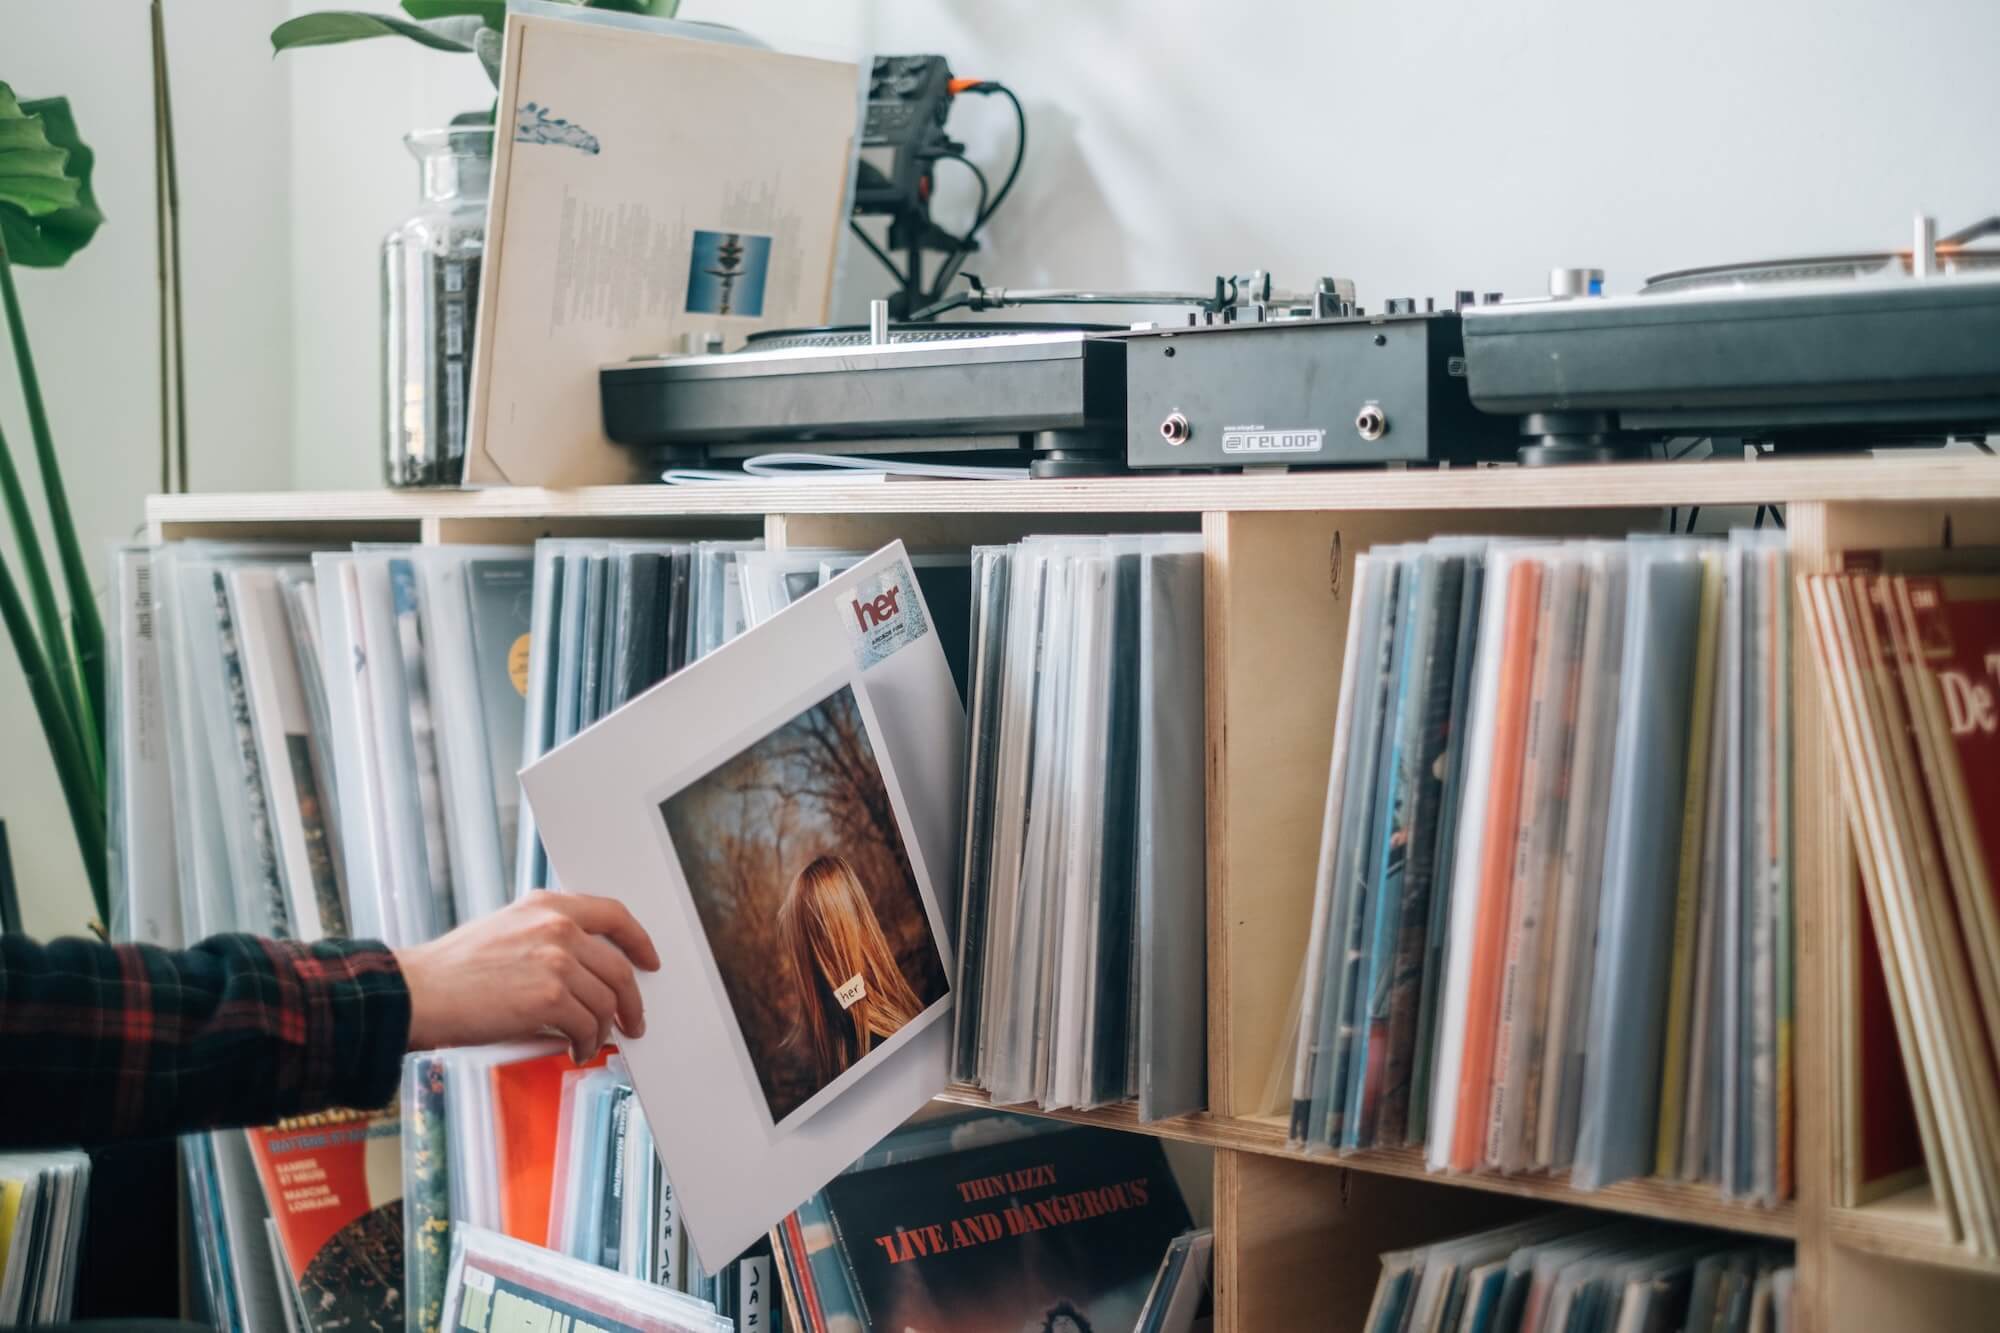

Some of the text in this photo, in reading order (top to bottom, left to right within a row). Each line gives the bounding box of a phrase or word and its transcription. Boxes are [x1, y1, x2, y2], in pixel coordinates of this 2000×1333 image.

[851, 585, 900, 633] her
[840, 984, 859, 1003] her
[956, 1164, 1057, 1203] THIN LIZZY
[950, 1213, 1004, 1249] AND
[748, 1265, 761, 1333] JAZ
